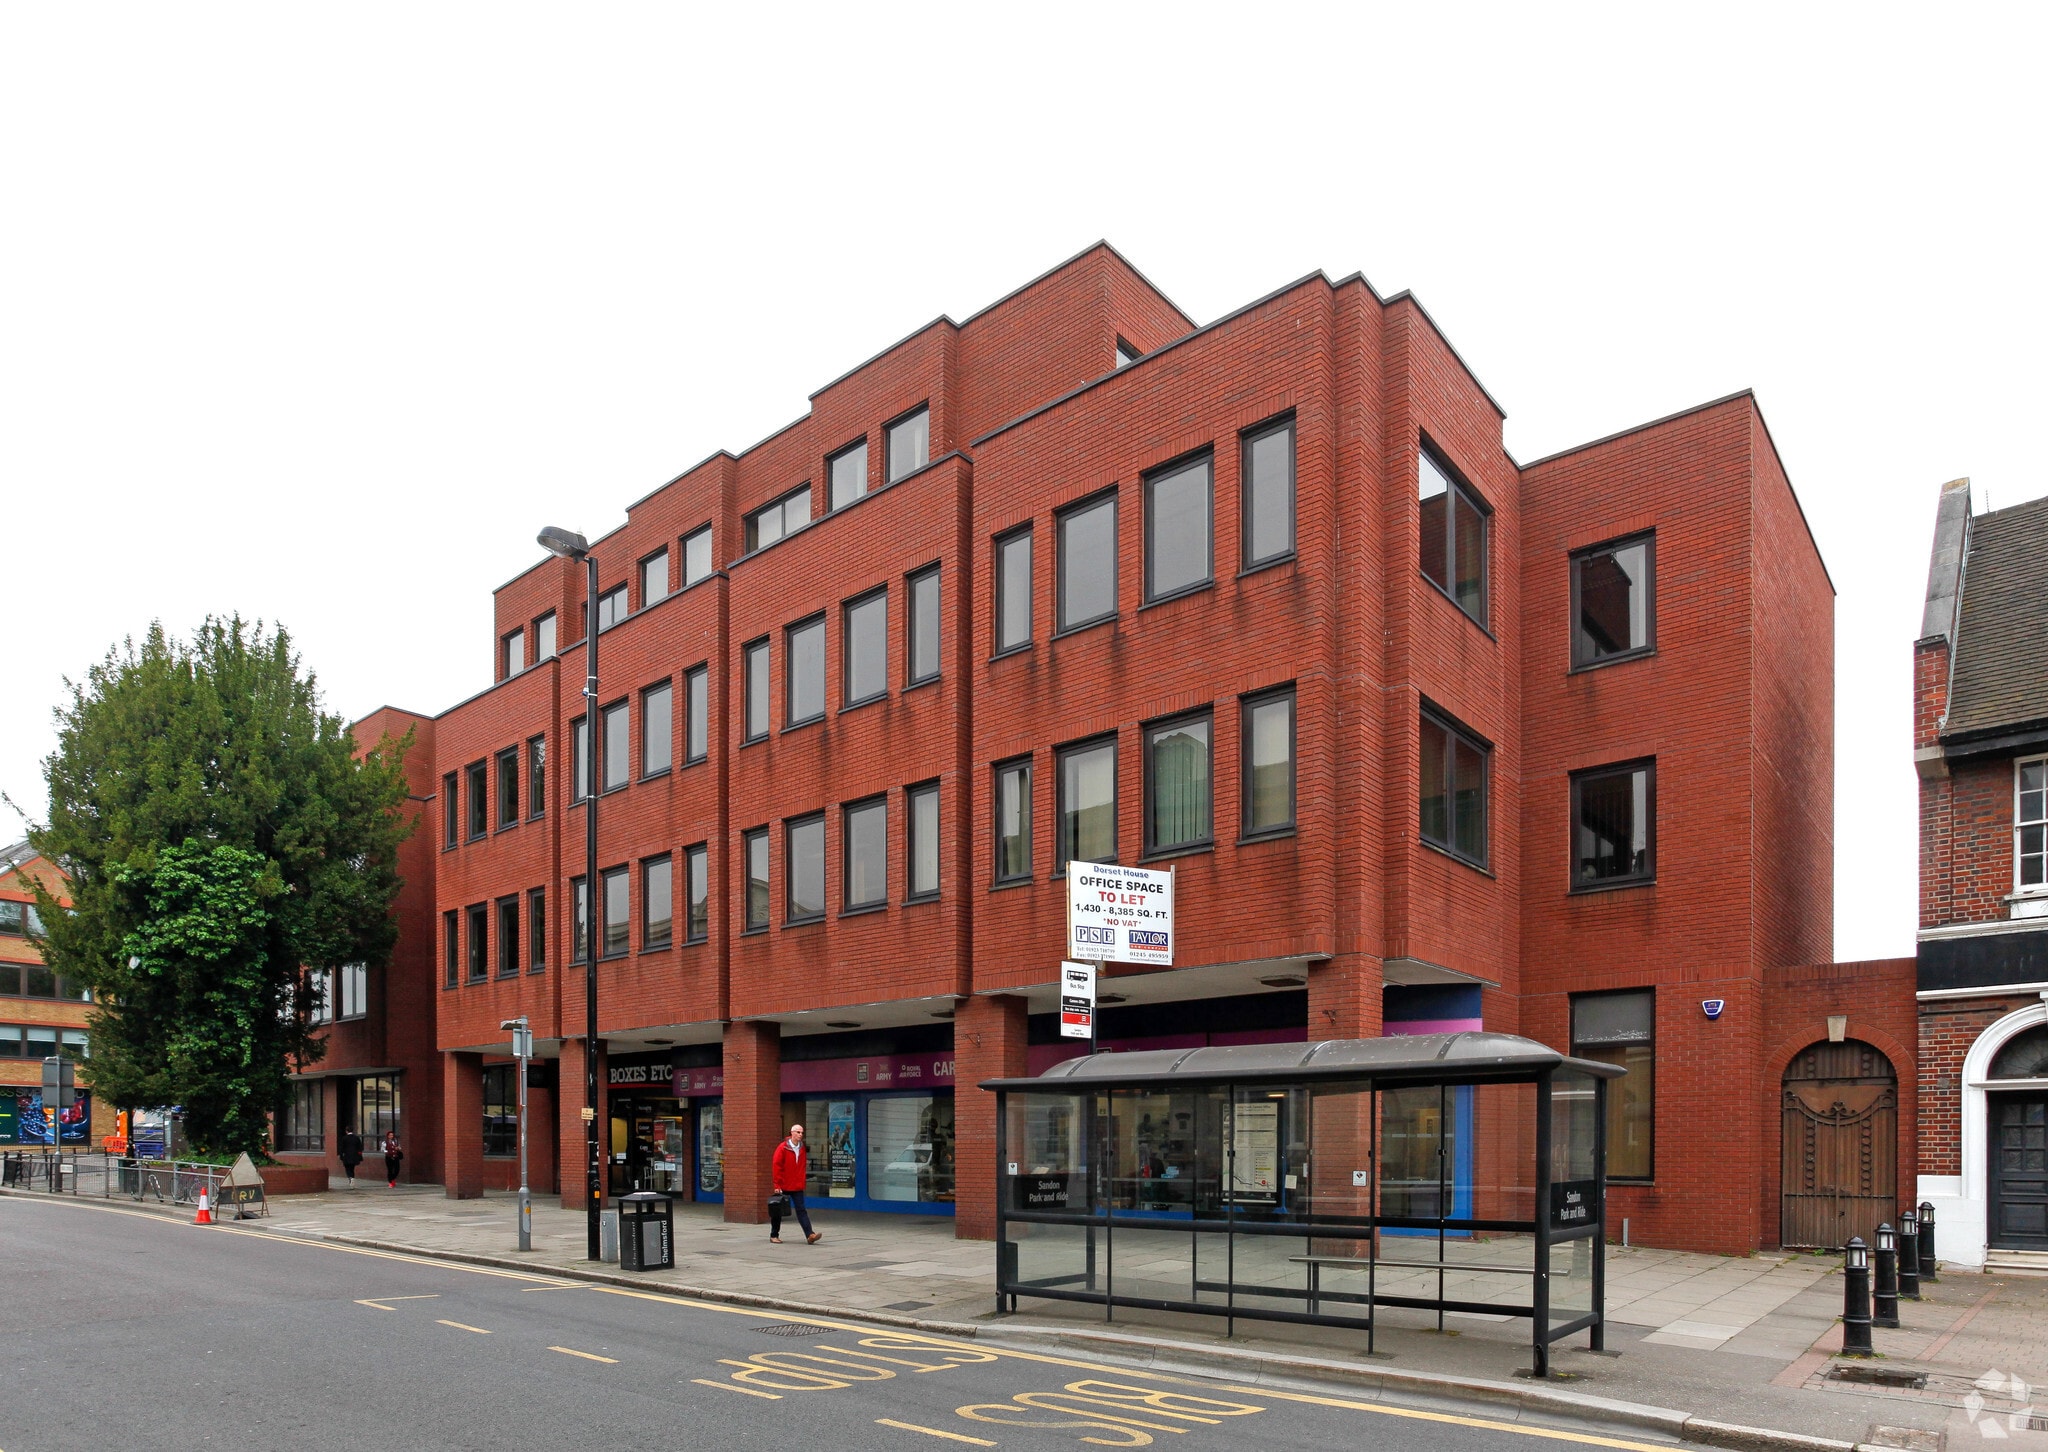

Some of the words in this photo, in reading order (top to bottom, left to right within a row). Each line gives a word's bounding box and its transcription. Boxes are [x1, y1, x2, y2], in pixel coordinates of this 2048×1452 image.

[1093, 865, 1121, 876] Dorset
[1123, 868, 1149, 879] House
[1080, 875, 1122, 889] OFFICE
[1126, 881, 1163, 894] SPACE
[1098, 891, 1116, 903] TO
[1121, 893, 1146, 905] LET
[1075, 903, 1100, 913] 1,430
[1109, 906, 1134, 916] 8,385
[1137, 909, 1153, 918] SQ.
[1156, 911, 1168, 919] FT.
[1130, 931, 1166, 945] TAYLOR
[610, 1066, 646, 1083] BOXES
[650, 1065, 673, 1081] ETC
[1038, 1181, 1060, 1190] Sandon
[1029, 1193, 1043, 1202] Park
[1044, 1192, 1055, 1201] and
[1056, 1192, 1069, 1201] Ride
[661, 1220, 669, 1264] Chelmsford
[716, 1337, 999, 1391] STOP
[954, 1379, 1268, 1448] BUS
